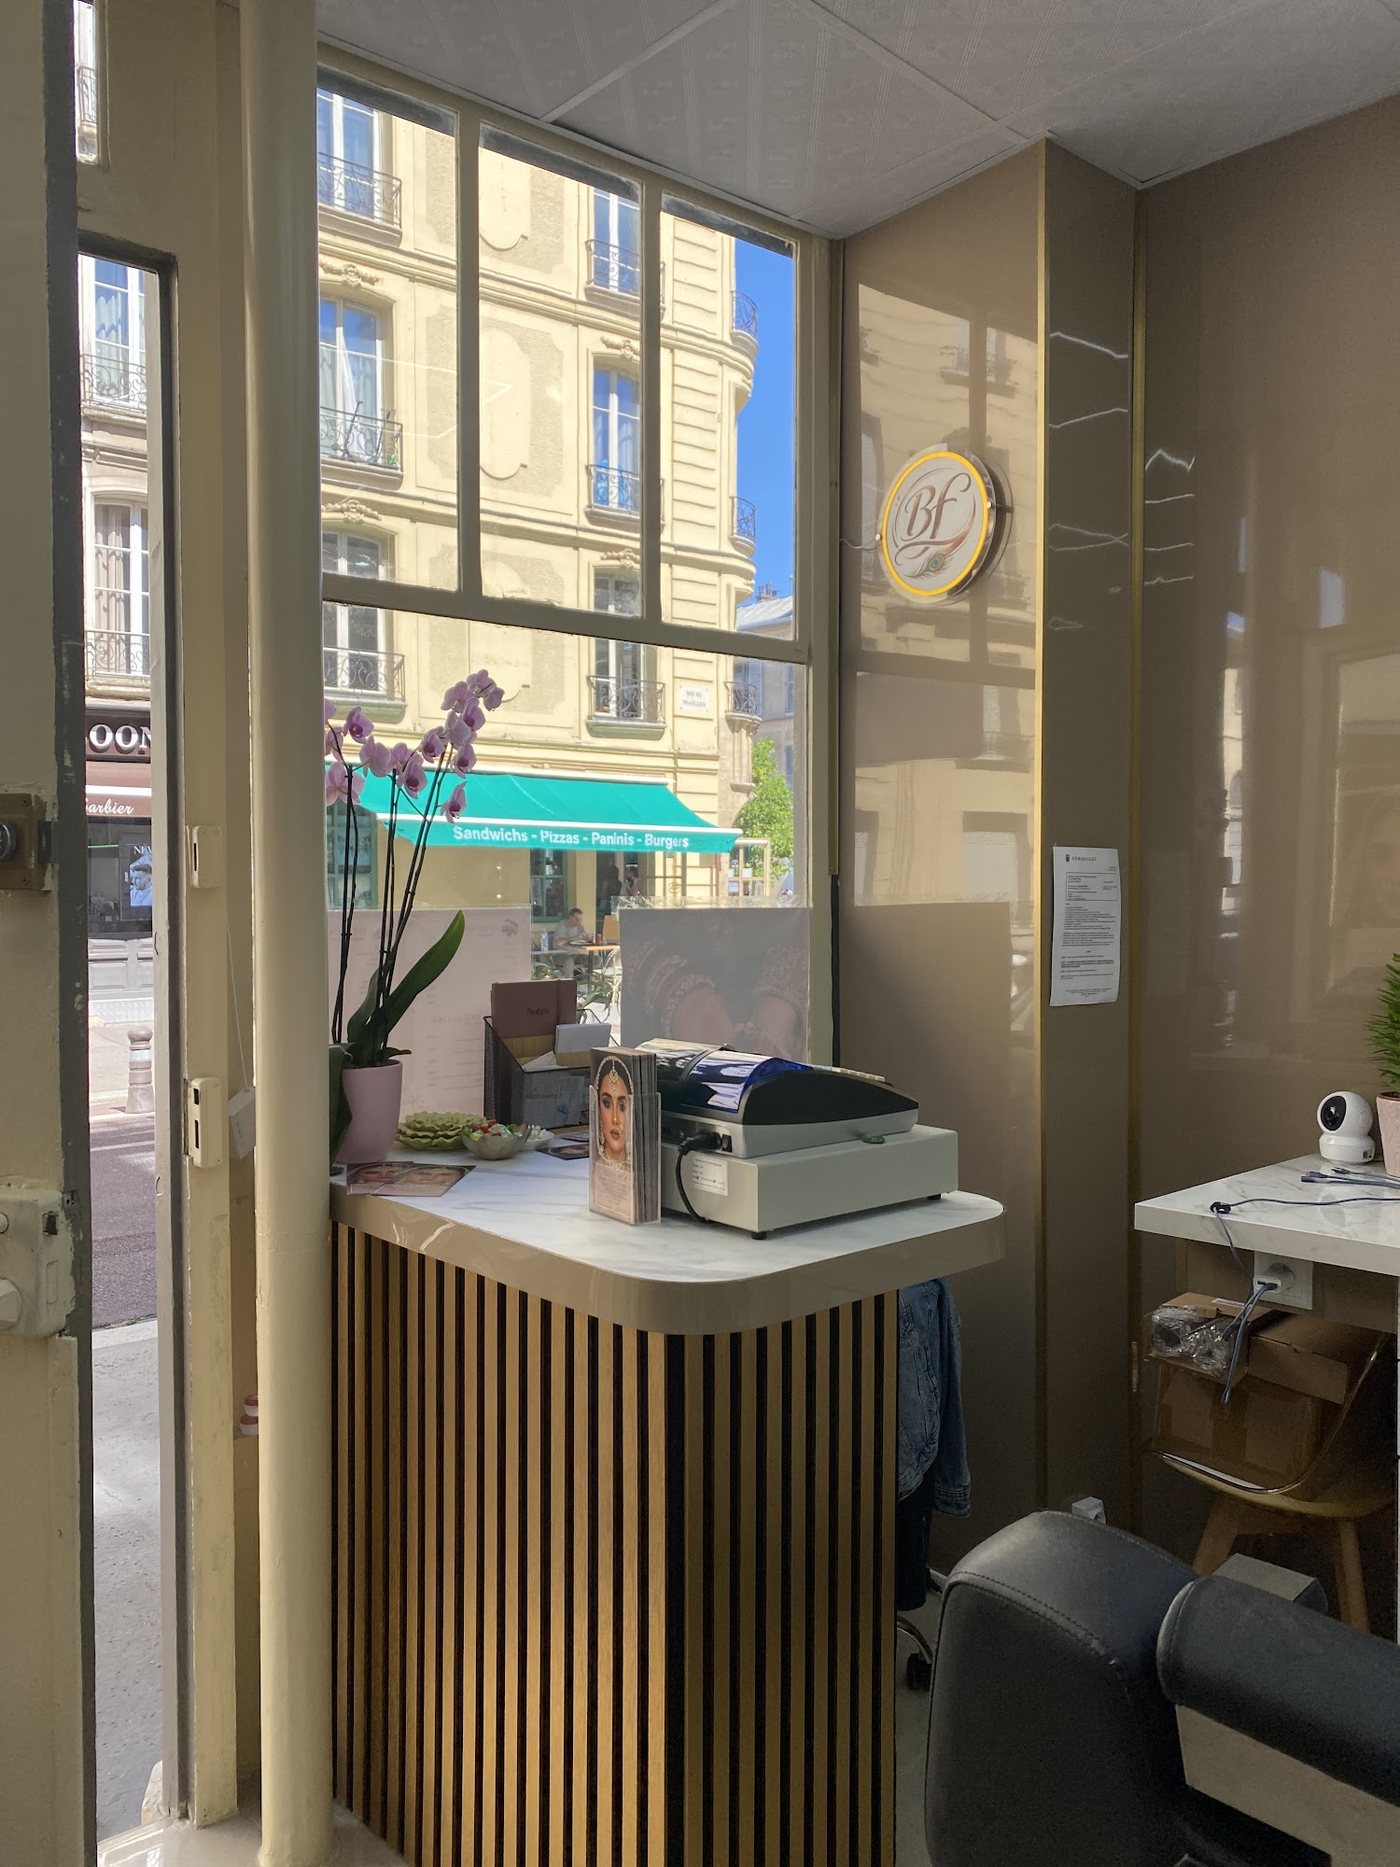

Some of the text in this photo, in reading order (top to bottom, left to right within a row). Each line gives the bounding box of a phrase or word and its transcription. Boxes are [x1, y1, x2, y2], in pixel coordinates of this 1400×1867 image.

[86, 723, 151, 749] OON
[453, 825, 528, 842] Sandwichs
[540, 829, 579, 844] Pizzas
[591, 832, 634, 846] Paninis
[644, 833, 689, 849] Burgers
